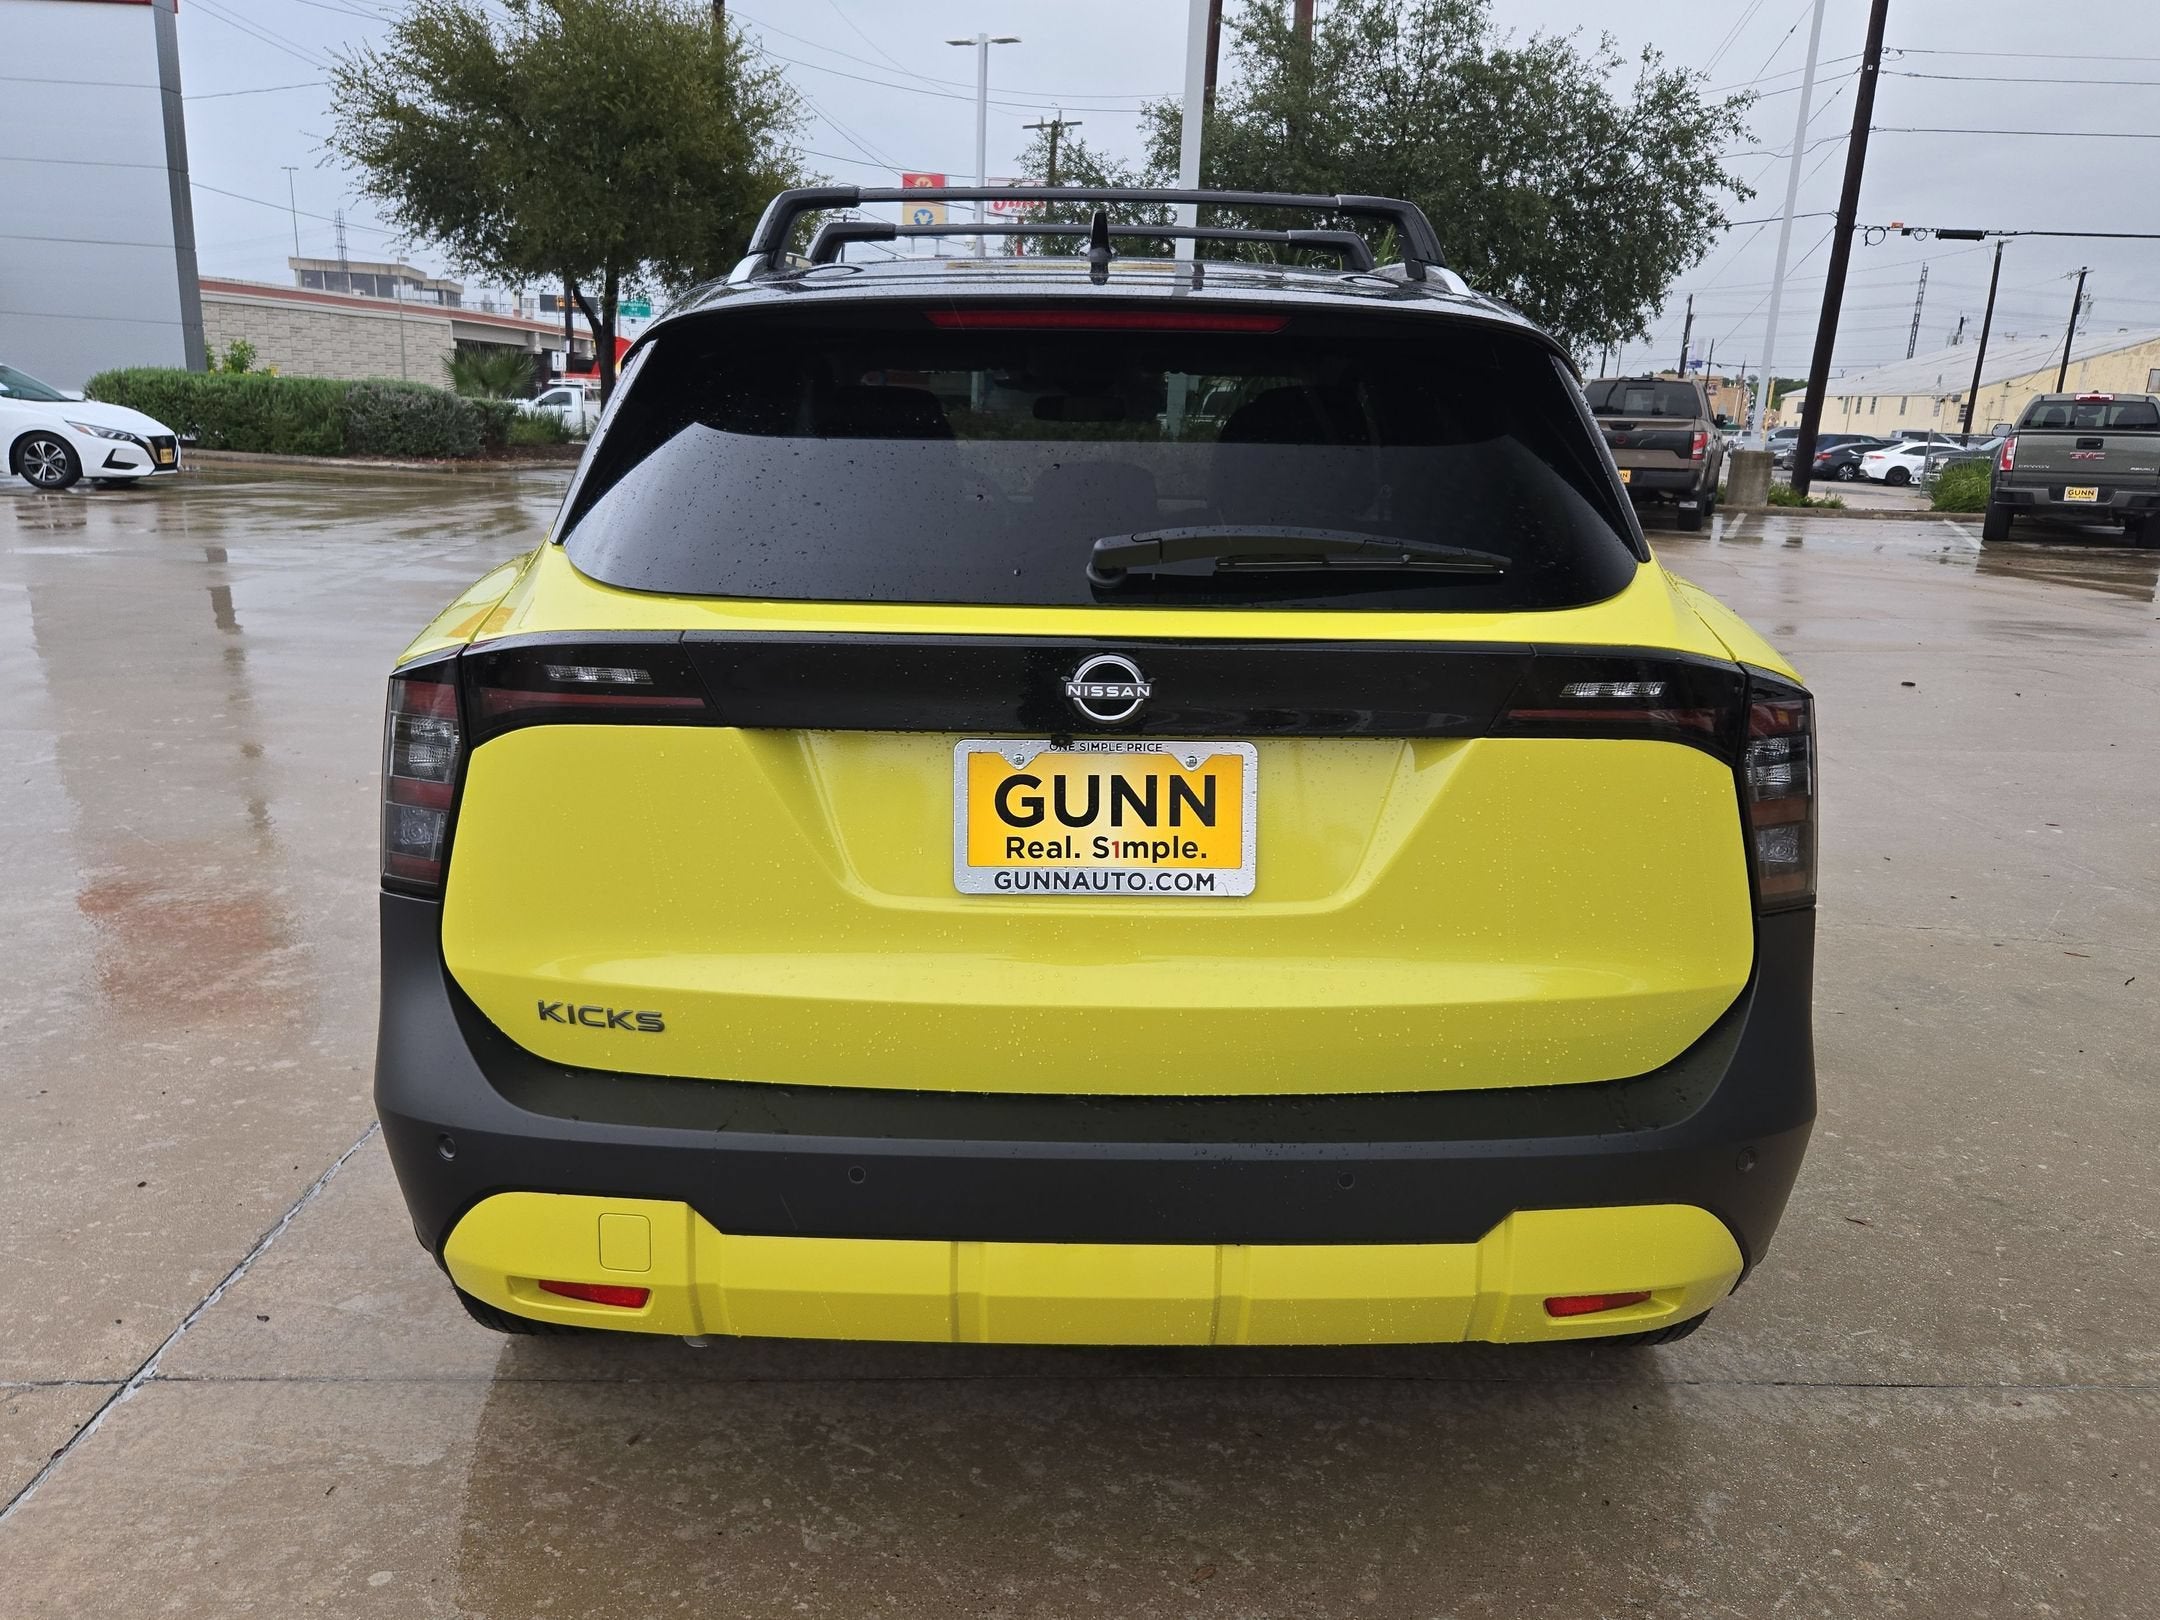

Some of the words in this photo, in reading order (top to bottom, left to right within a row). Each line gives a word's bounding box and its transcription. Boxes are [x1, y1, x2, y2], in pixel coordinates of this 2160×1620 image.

[2069, 451, 2106, 460] GMC
[1066, 684, 1150, 698] NISSAN
[1079, 742, 1123, 752] SIMPLE
[1126, 743, 1163, 752] PRICE
[994, 774, 1216, 828] GUNN
[1006, 836, 1081, 859] Real.
[994, 871, 1215, 891] GUNNAUTO.COM
[537, 999, 665, 1033] KICKS
